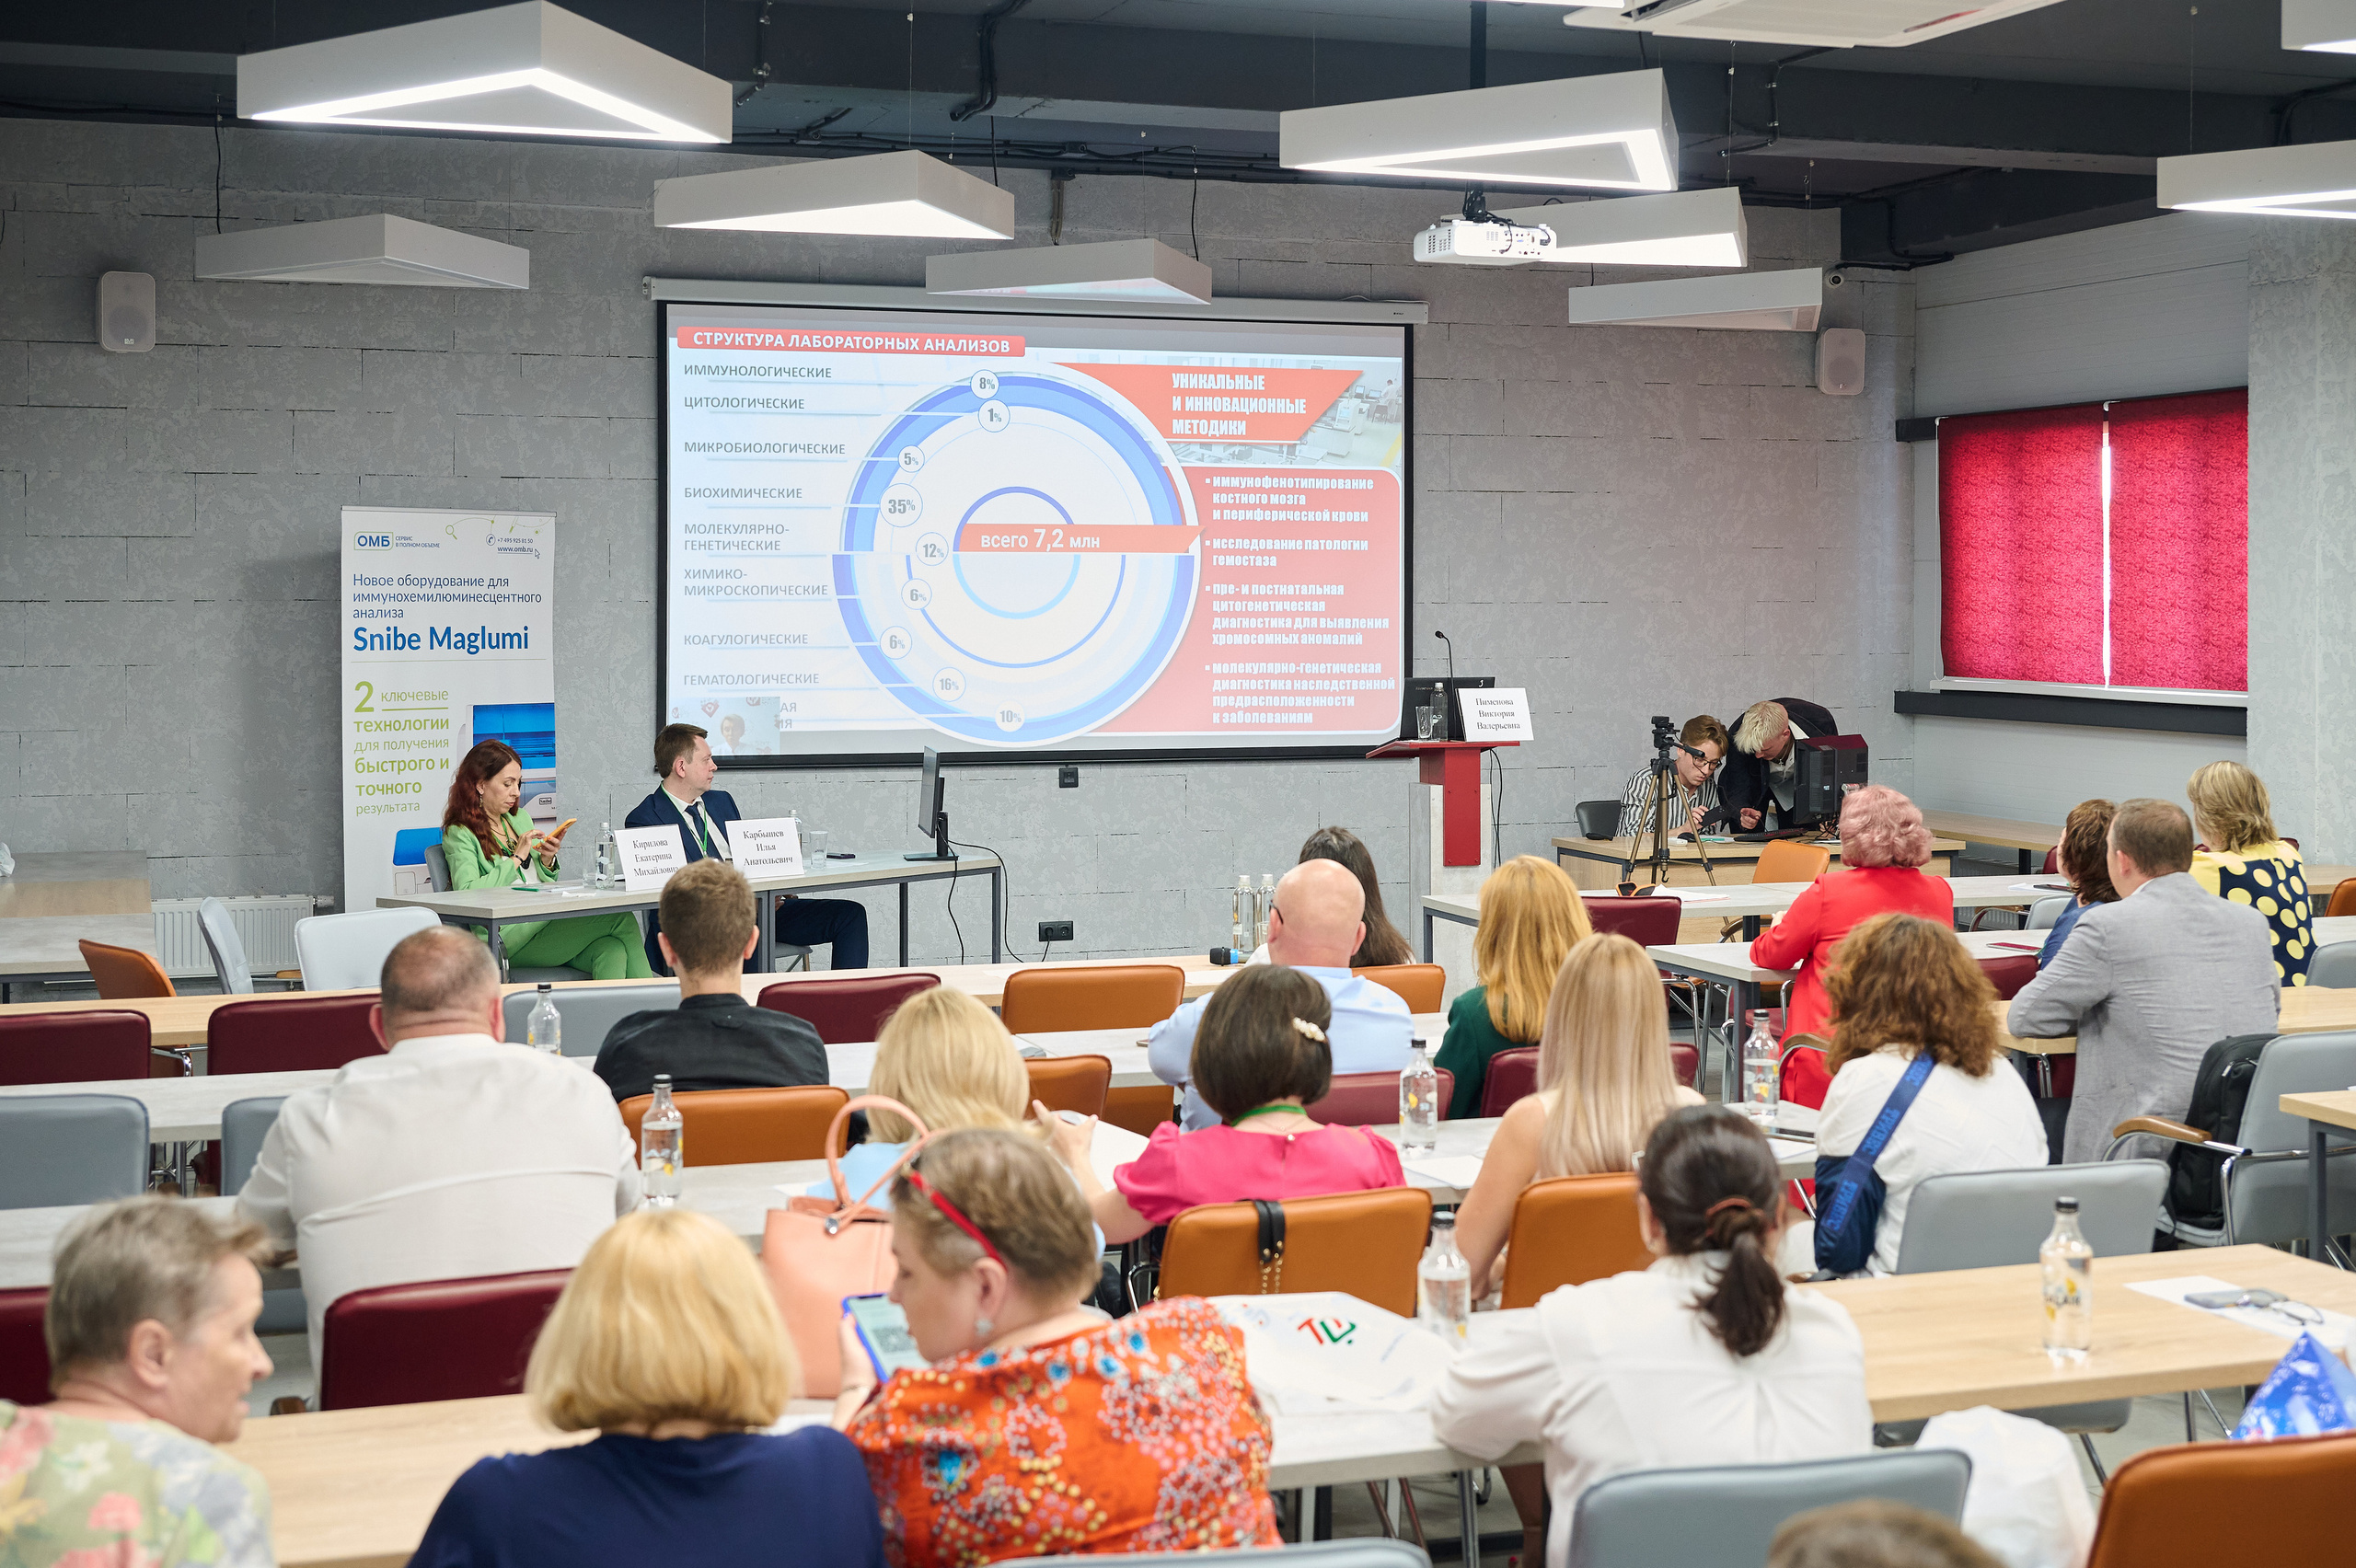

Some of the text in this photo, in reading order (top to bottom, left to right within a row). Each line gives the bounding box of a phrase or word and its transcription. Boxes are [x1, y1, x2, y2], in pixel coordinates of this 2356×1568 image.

[693, 331, 1011, 353] СТРУКТУРА ЛАБОРАТОРНЫХ АНАЛИЗОВ
[684, 363, 832, 379] ИММУНОЛОГИЧЕСКИЕ
[979, 377, 996, 390] 8%
[1172, 373, 1265, 391] УНИКАЛЬНЫЕ
[684, 397, 805, 410] ЦИТОЛОГИЧЕСКИЕ
[1172, 396, 1307, 415] И ИННОВАЦИОННЫЕ
[987, 408, 1002, 423] 1%
[1172, 420, 1246, 437] МЕТОДИКИ
[684, 442, 846, 455] МИКРОБИОЛОГИЧЕСКИЕ
[904, 453, 918, 466] 5%
[1213, 475, 1374, 490] иммунофенотипирование
[684, 487, 803, 499] БИОХИМИЧЕСКИЕ
[1213, 493, 1306, 505] костного мозга
[888, 499, 916, 513] 35%
[1213, 508, 1369, 523] и периферической крови
[684, 524, 790, 535] МОЛЕКУЛЯРНО-
[357, 535, 390, 548] ОМБ
[684, 539, 780, 551] ГЕНЕТИЧЕСКИЕ
[981, 529, 1100, 552] всего 7,2 млн
[1213, 538, 1369, 551] исследование патологии
[923, 543, 944, 558] 12%
[1213, 555, 1276, 567] гемостаза
[684, 569, 747, 580] ХИМИКО-
[353, 574, 509, 589] Новое оборудование для
[684, 584, 828, 596] МИКРОСКОПИЧЕСКИЕ
[910, 589, 927, 603] 6%
[1213, 584, 1345, 596] пре- и постнатальная
[353, 592, 542, 605] иммунохемилюминесцентного
[353, 608, 404, 618] анализа
[1213, 601, 1326, 613] цитогенетическая
[1213, 617, 1390, 630] диагностика для выявления
[353, 625, 528, 655] Snibe Maglumi
[684, 633, 808, 645] КОАГУЛОГИЧЕСКИЕ
[889, 635, 906, 650] 6%
[1212, 632, 1363, 646] хромосомных аномалий
[1213, 663, 1381, 674] молекулярно-генетическая
[684, 674, 819, 686] ГЕМАТОЛОГИЧЕСКИЕ
[939, 677, 959, 691] 16%
[1213, 677, 1395, 692] диагностика наследственной
[354, 681, 449, 713] 2 ключевые
[1213, 696, 1355, 709] предрасположенности
[1475, 698, 1514, 706] Пименова
[999, 709, 1022, 723] 10%
[1213, 710, 1312, 724] к заболеваниям
[1478, 710, 1515, 719] Виктория
[353, 717, 449, 732] технологии
[1476, 721, 1521, 732] Валерьевна
[353, 737, 449, 754] для получения
[354, 757, 449, 775] быстрого и
[355, 781, 422, 797] точного
[356, 801, 421, 817] результата
[743, 829, 784, 840] Карбышев
[632, 838, 668, 849] Кирилова
[756, 843, 777, 852] Илья
[634, 852, 673, 864] Екатерина
[744, 856, 793, 867] Анатольевич
